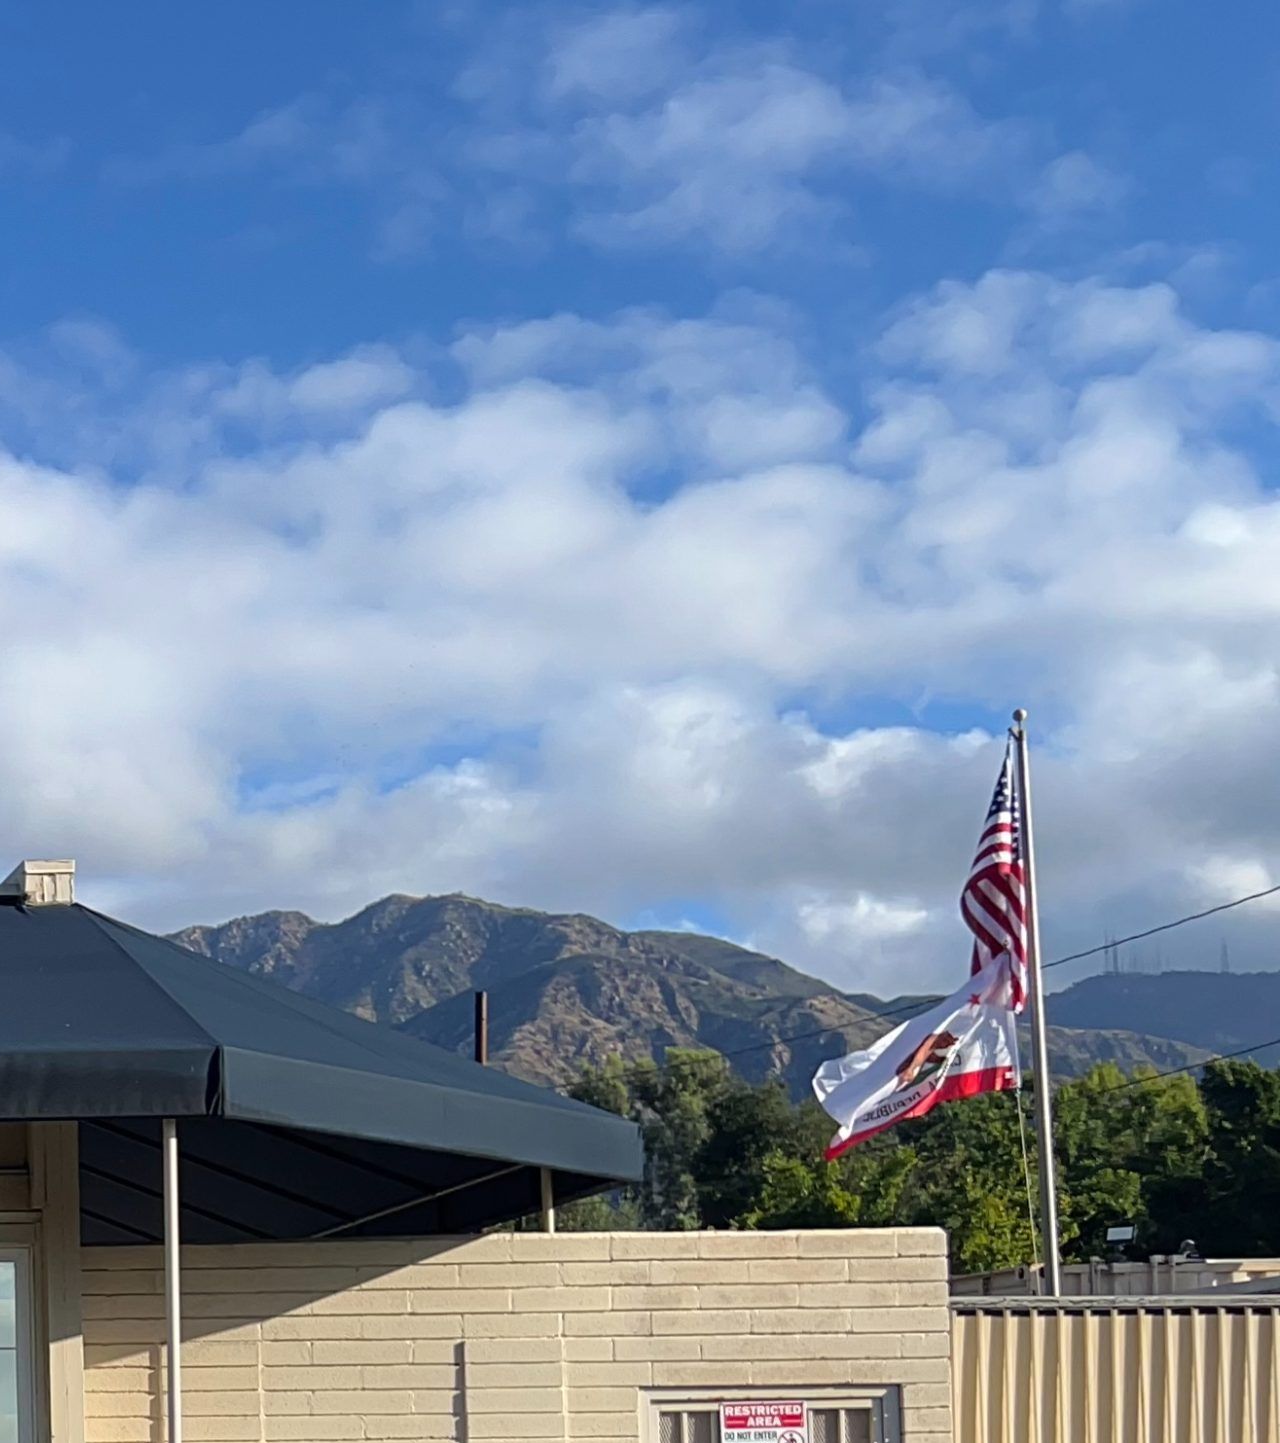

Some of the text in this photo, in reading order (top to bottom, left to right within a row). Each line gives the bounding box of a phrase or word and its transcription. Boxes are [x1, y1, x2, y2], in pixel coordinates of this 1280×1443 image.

[724, 1405, 802, 1416] RESTRICTED
[746, 1416, 782, 1426] AREA
[724, 1431, 778, 1440] DO NOT ENTER
